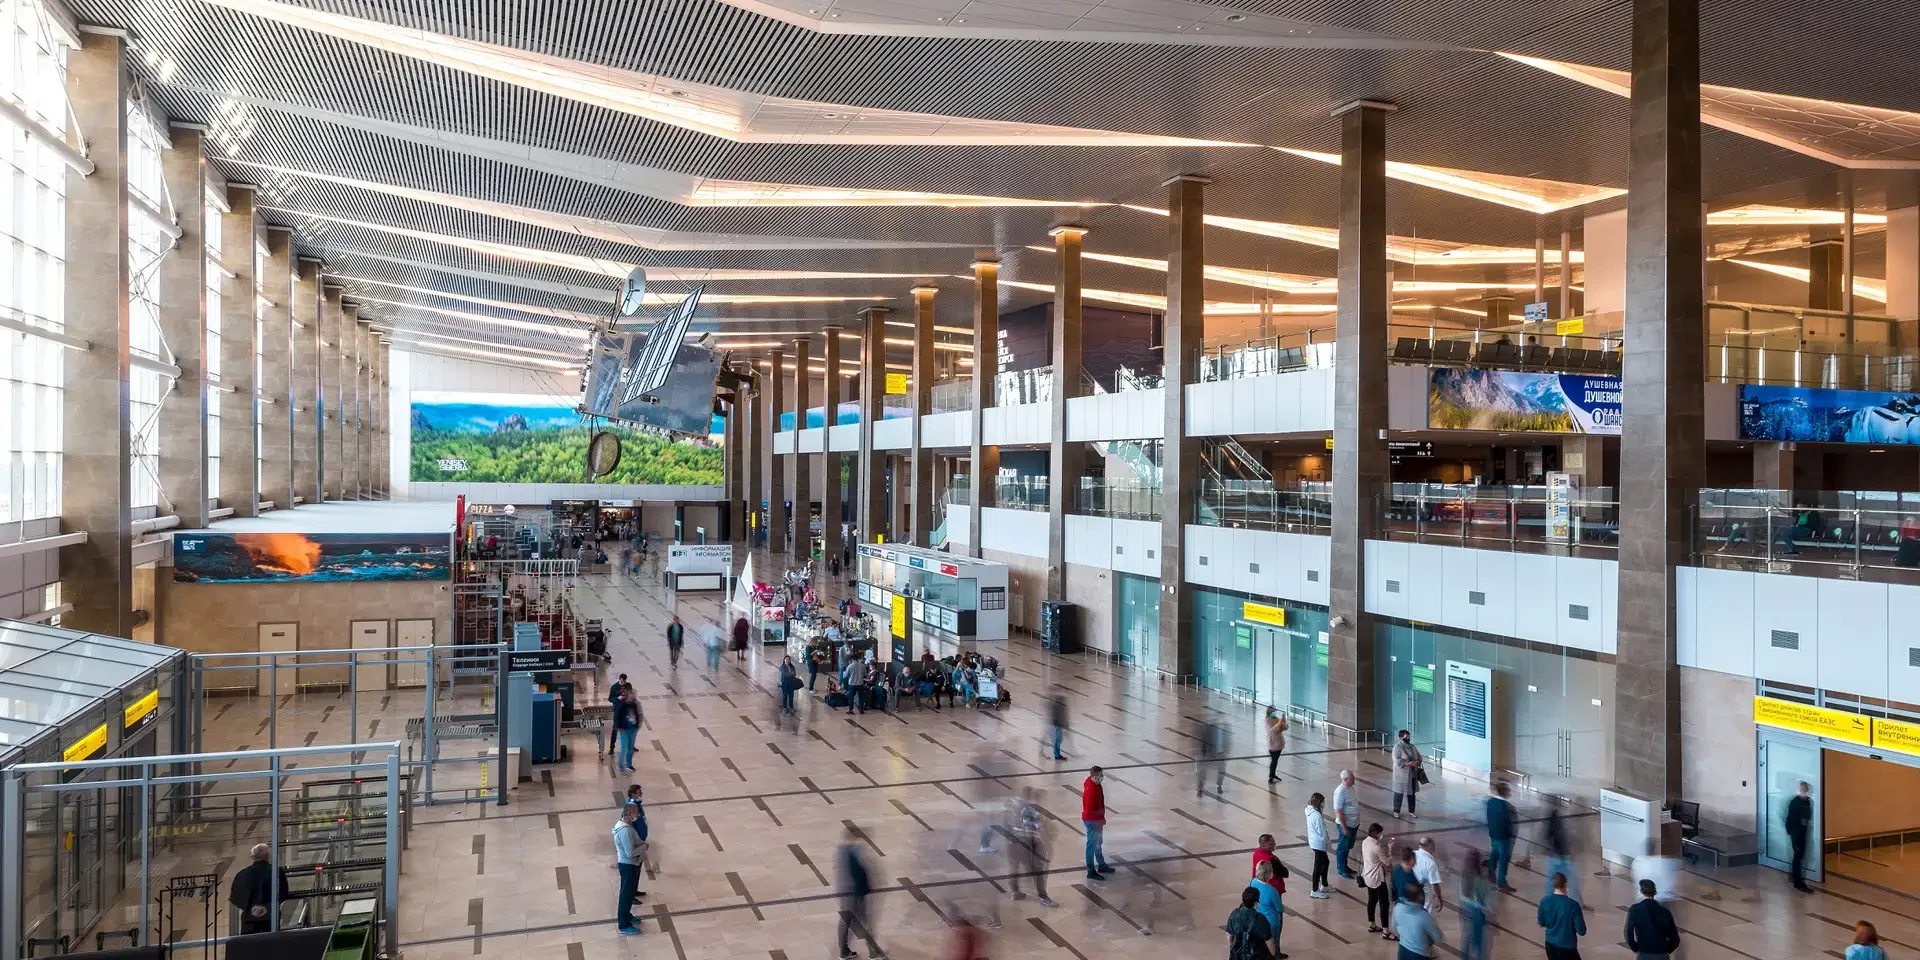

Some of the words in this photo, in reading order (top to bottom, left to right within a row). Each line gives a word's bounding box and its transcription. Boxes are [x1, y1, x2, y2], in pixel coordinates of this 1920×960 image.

[1584, 380, 1623, 390] ДУШЕВНАЯ
[470, 504, 493, 514] PIZZA
[1759, 699, 1779, 709] Прилет
[1758, 705, 1798, 719] Таможенного
[1878, 721, 1908, 733] Прилет
